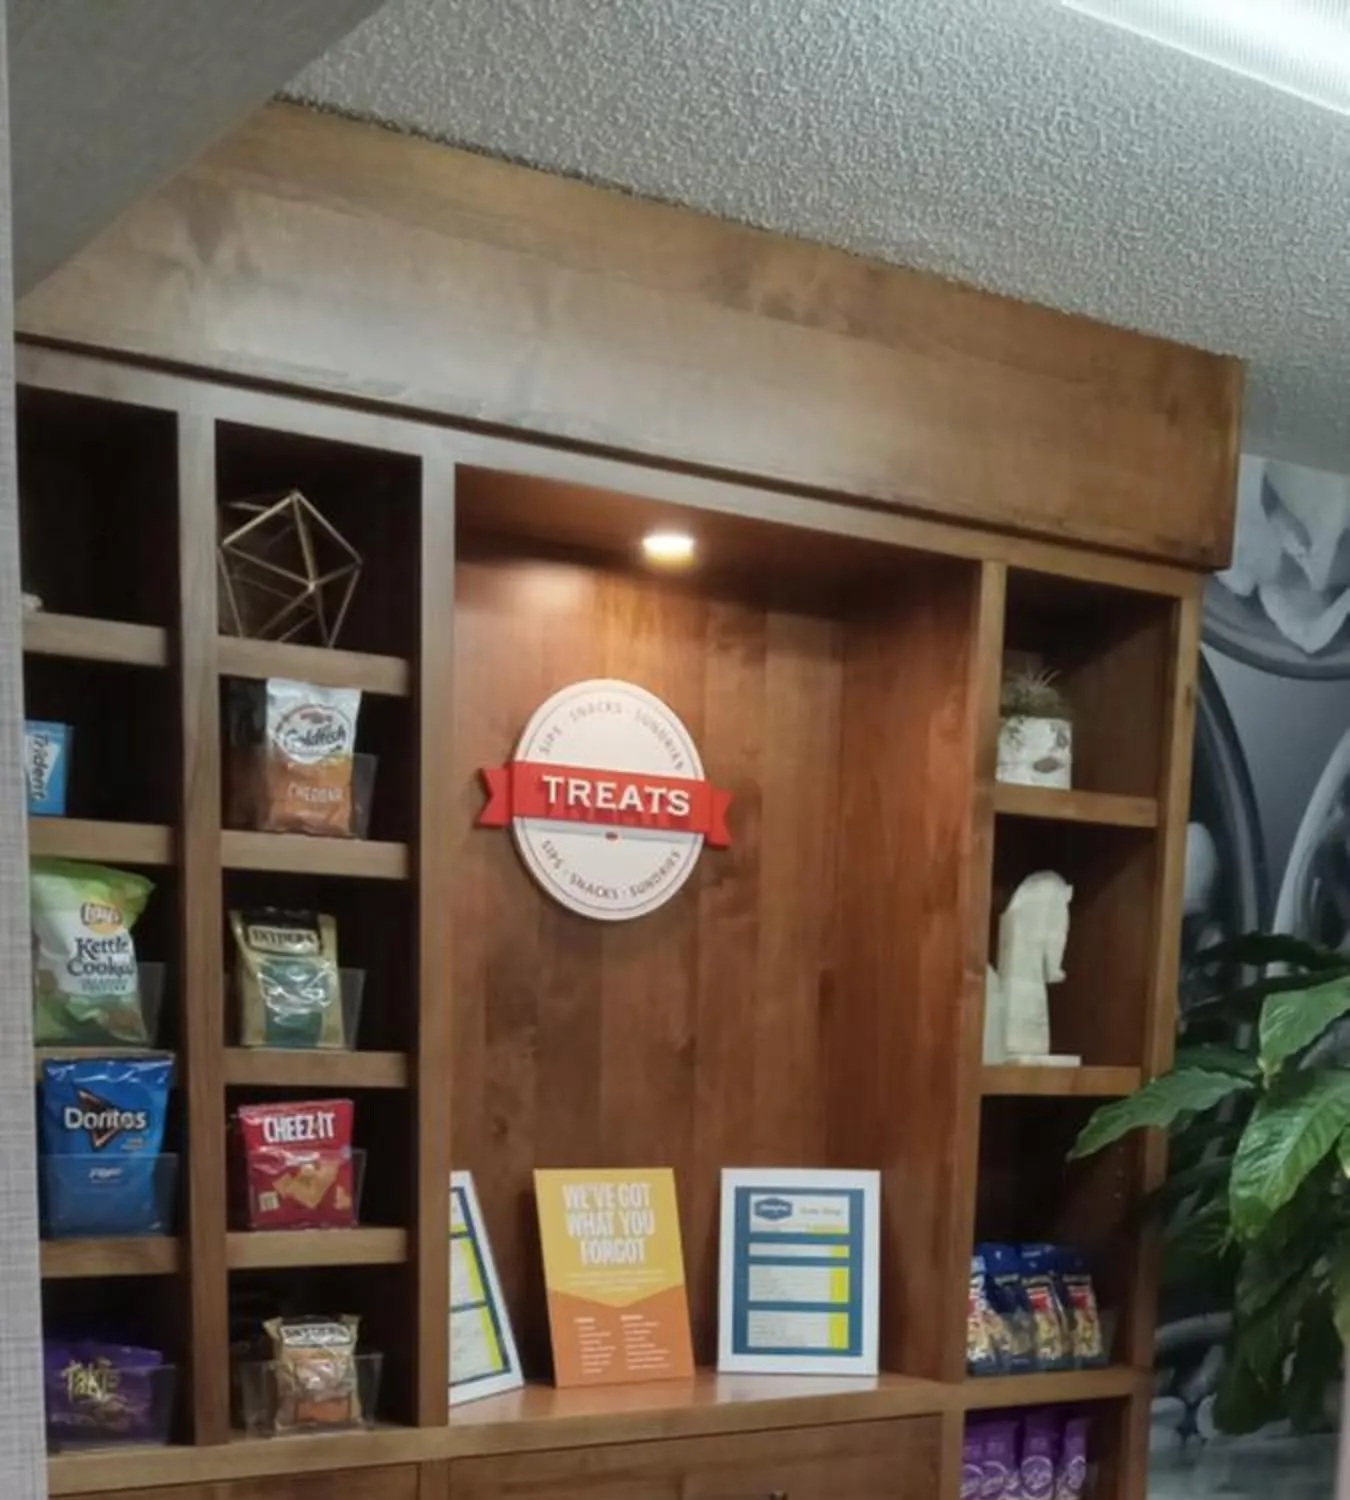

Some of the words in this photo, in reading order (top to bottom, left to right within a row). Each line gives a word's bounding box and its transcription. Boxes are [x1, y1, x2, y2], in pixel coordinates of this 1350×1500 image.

[33, 733, 49, 800] Trident
[542, 775, 690, 816] TREATS
[541, 840, 563, 869] SIPS
[570, 873, 618, 899] SNACKS
[629, 851, 681, 897] SUNDRIES
[64, 1107, 147, 1130] Doritos
[562, 1183, 613, 1210] WE'VE
[617, 1183, 652, 1209] GOT
[565, 1210, 614, 1239] WHAT
[618, 1209, 655, 1237] YOU
[580, 1238, 645, 1265] FORGOT
